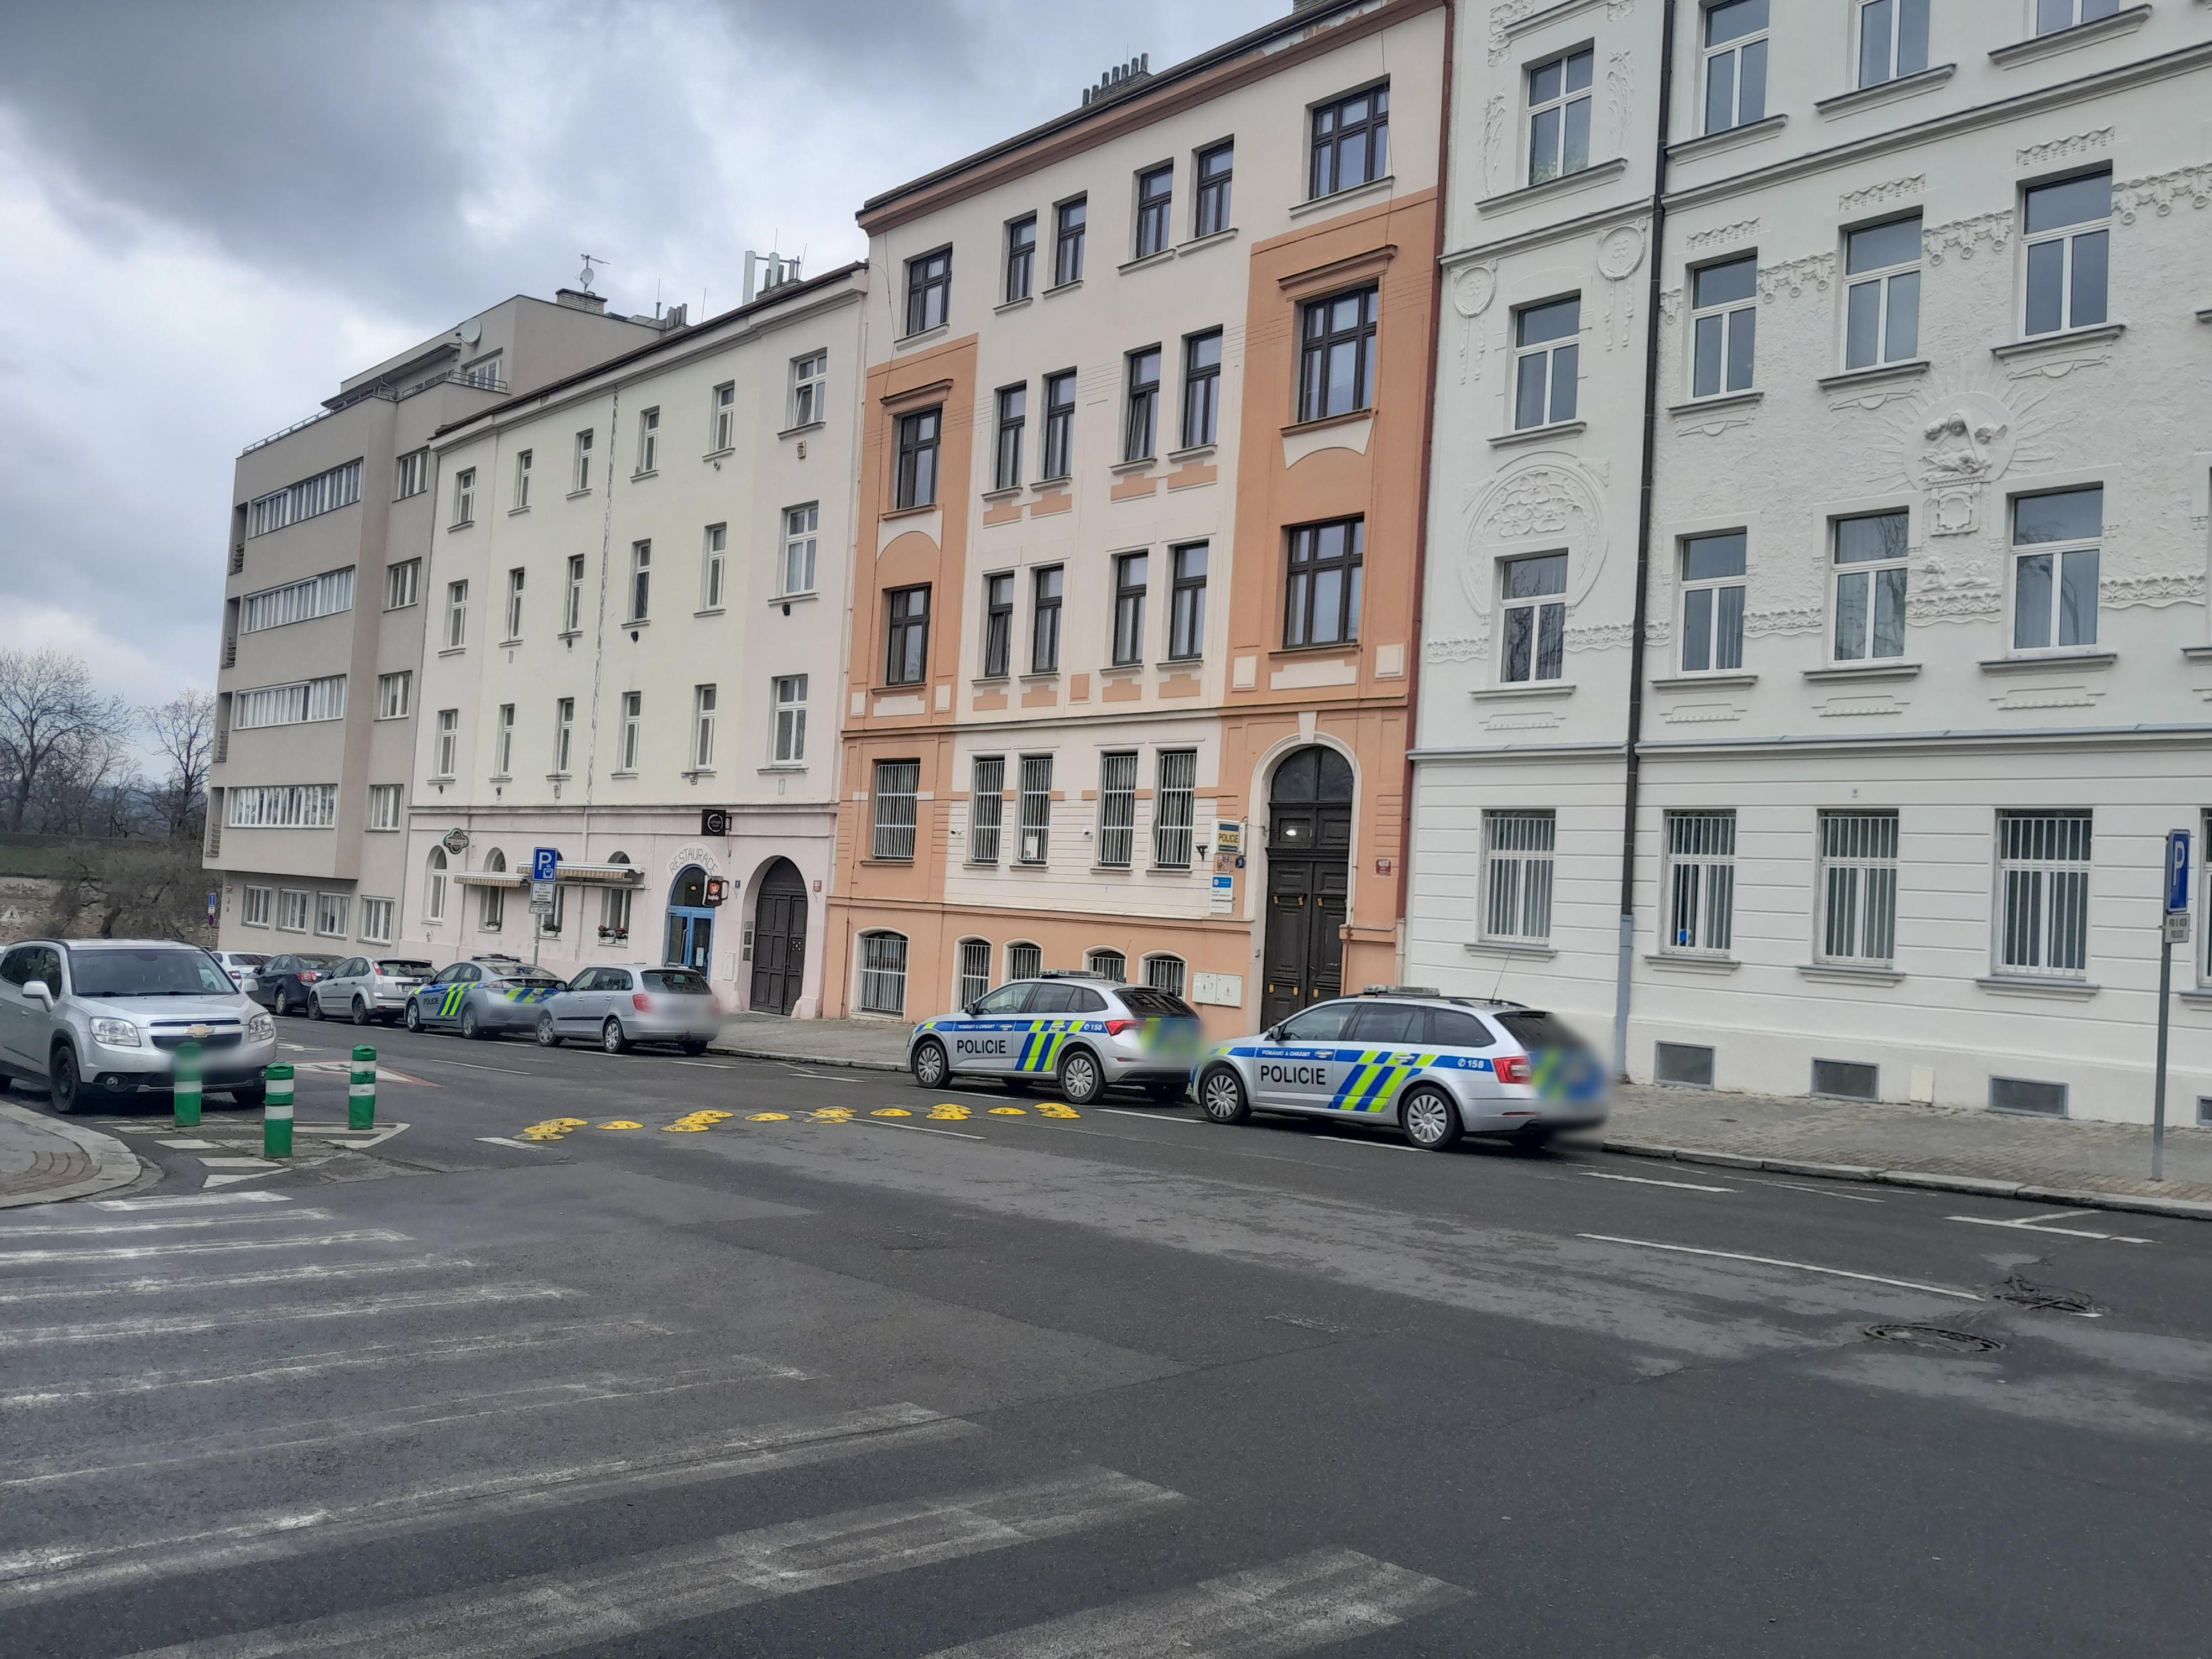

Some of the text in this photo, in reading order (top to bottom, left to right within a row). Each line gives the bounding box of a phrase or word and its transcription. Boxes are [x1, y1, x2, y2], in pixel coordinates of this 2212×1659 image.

[1218, 833, 1239, 843] POLICIE
[538, 852, 552, 871] P
[669, 847, 718, 875] RESTAURACE
[2173, 841, 2185, 886] P
[957, 1039, 1006, 1054] POLICIE
[1467, 1060, 1484, 1069] 158
[1261, 1065, 1327, 1086] POLICIE
